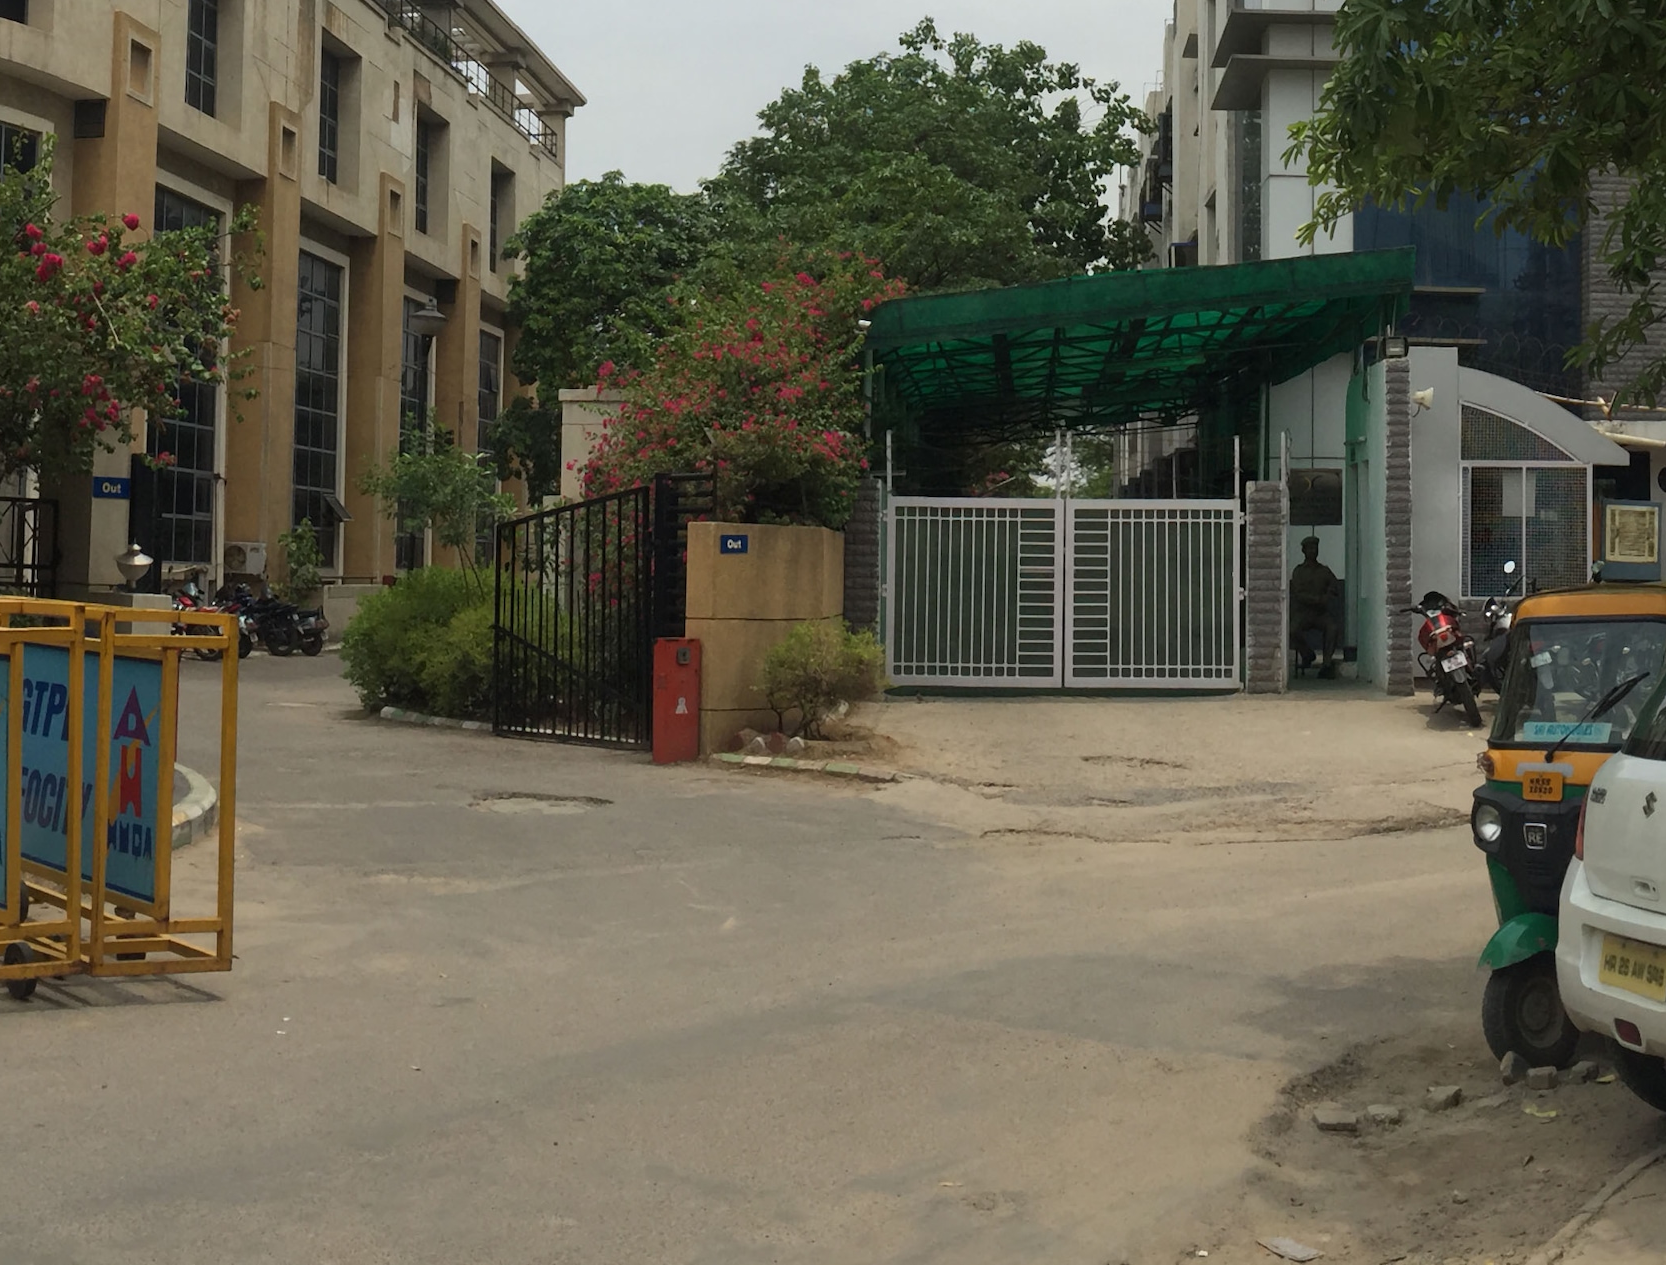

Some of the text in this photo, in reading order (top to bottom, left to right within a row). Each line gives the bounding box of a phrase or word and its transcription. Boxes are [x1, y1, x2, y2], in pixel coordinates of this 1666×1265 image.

[102, 481, 121, 494] Out
[727, 538, 742, 549] Out
[1527, 831, 1544, 845] RE
